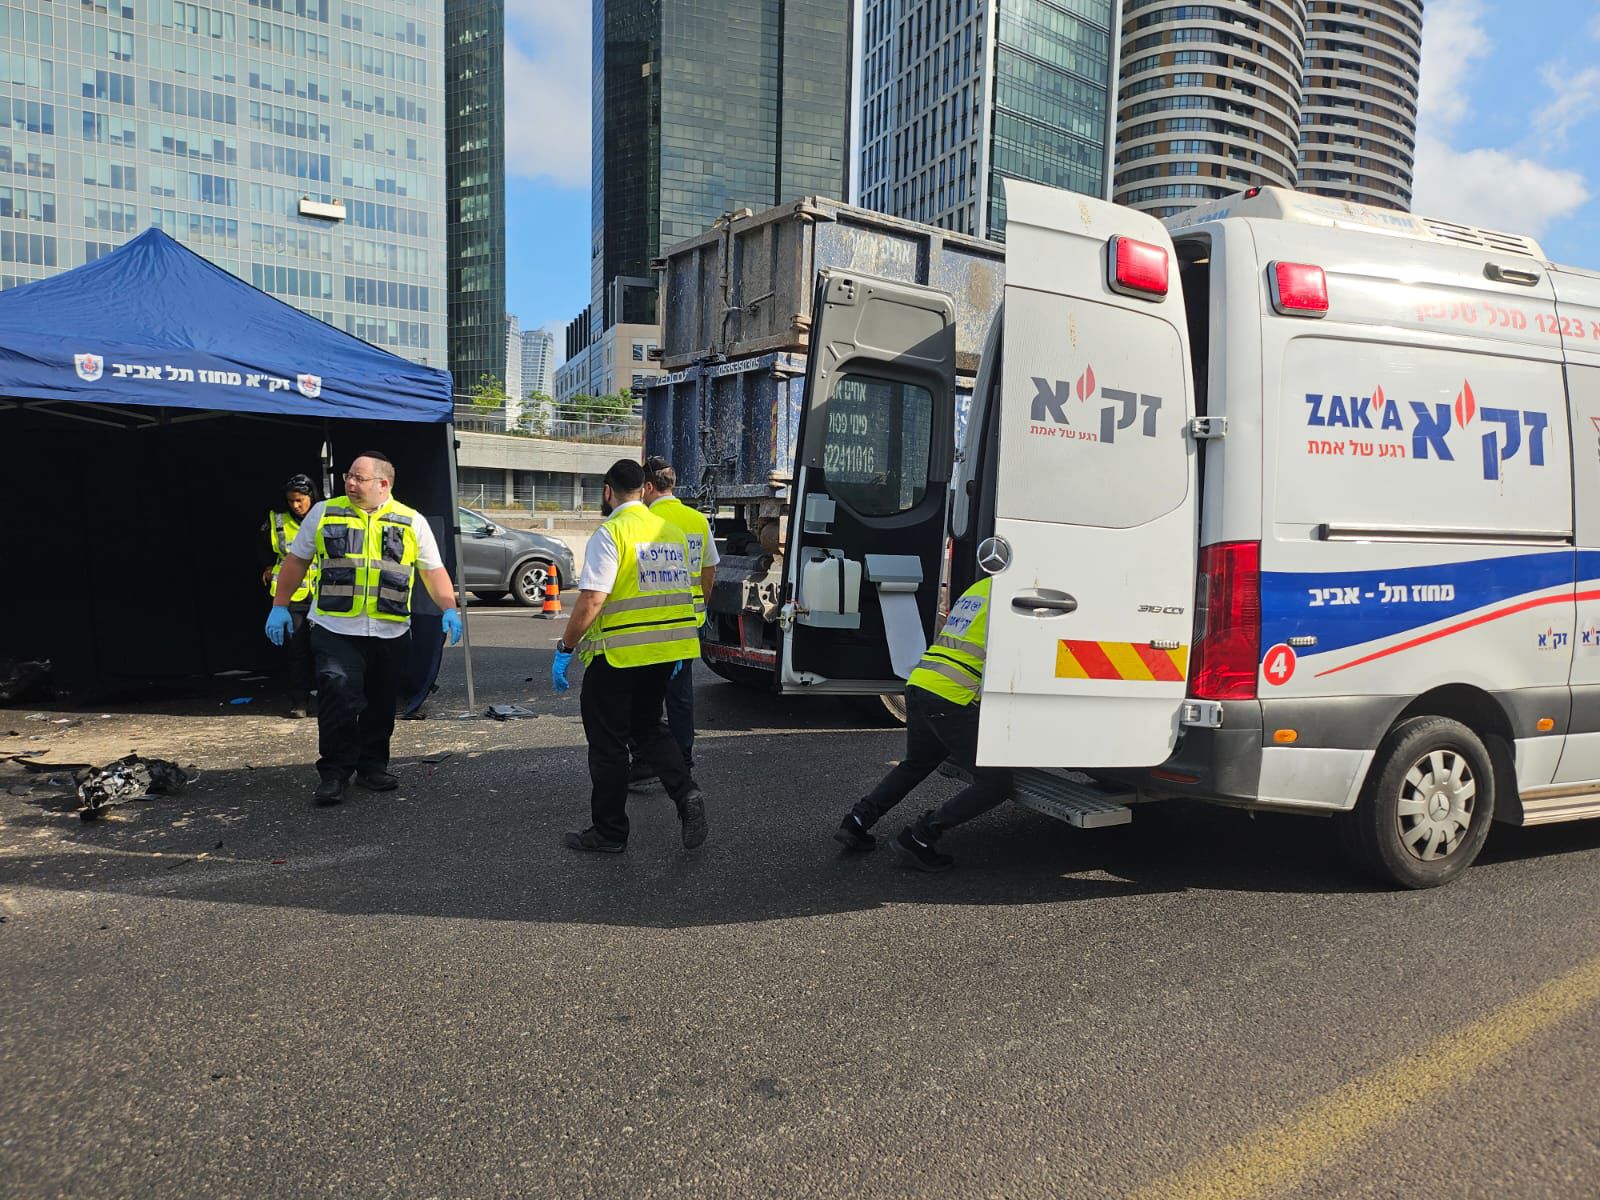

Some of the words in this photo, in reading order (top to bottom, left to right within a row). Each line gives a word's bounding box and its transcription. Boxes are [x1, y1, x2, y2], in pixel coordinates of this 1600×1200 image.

[1481, 299, 1527, 330] מכל
[1535, 313, 1585, 338] 1223
[112, 363, 162, 380] אביב
[165, 365, 195, 382] תל
[198, 369, 242, 386] מחוז
[1030, 425, 1057, 436] אמת
[1059, 427, 1076, 439] של
[1078, 431, 1098, 442] רגע
[1307, 440, 1345, 455] אמת
[1349, 439, 1374, 456] של
[1378, 443, 1405, 458] רגע
[1308, 587, 1361, 607] אביב
[1378, 582, 1408, 603] תל
[1411, 584, 1455, 602] מחוז
[1269, 652, 1287, 678] 4
